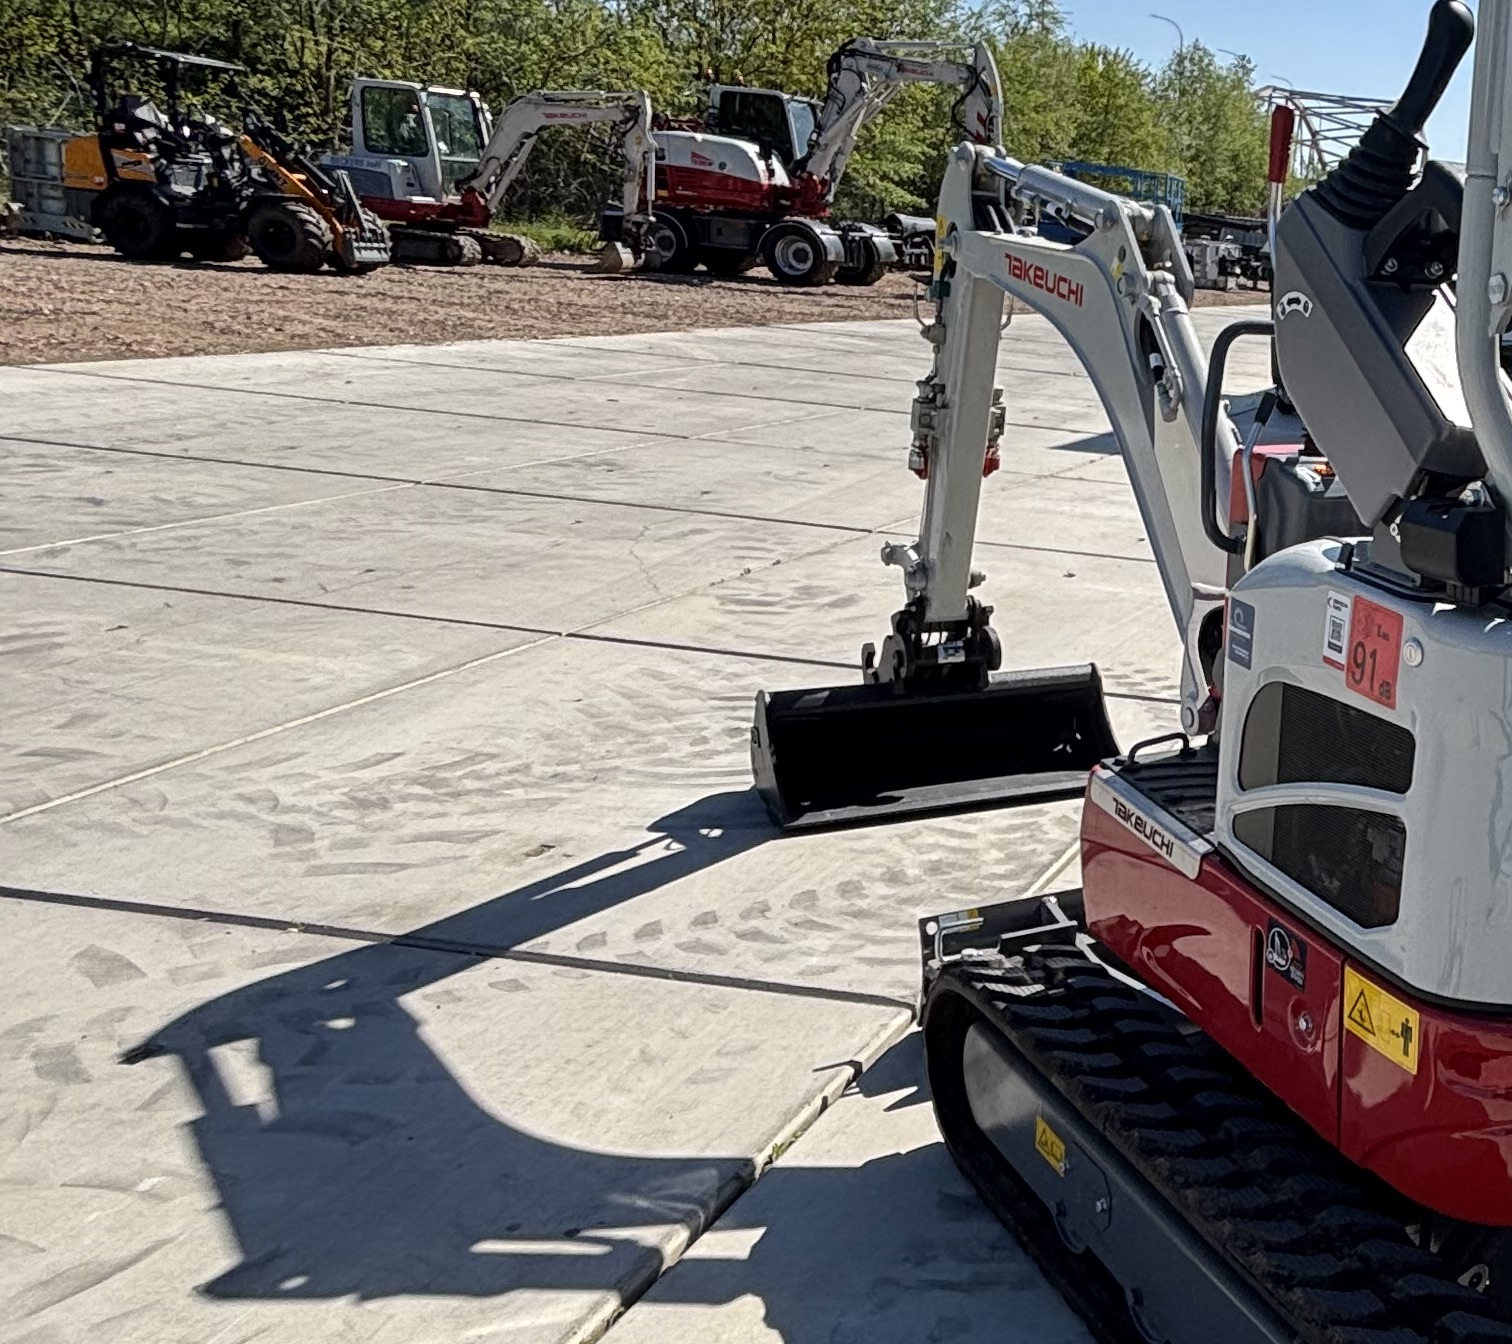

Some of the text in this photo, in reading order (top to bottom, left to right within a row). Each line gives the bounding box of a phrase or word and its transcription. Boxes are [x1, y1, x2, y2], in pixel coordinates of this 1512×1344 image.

[1005, 252, 1084, 308] TAKEUCHI
[1351, 640, 1377, 693] 91
[1112, 796, 1175, 858] TAKEUCHI
